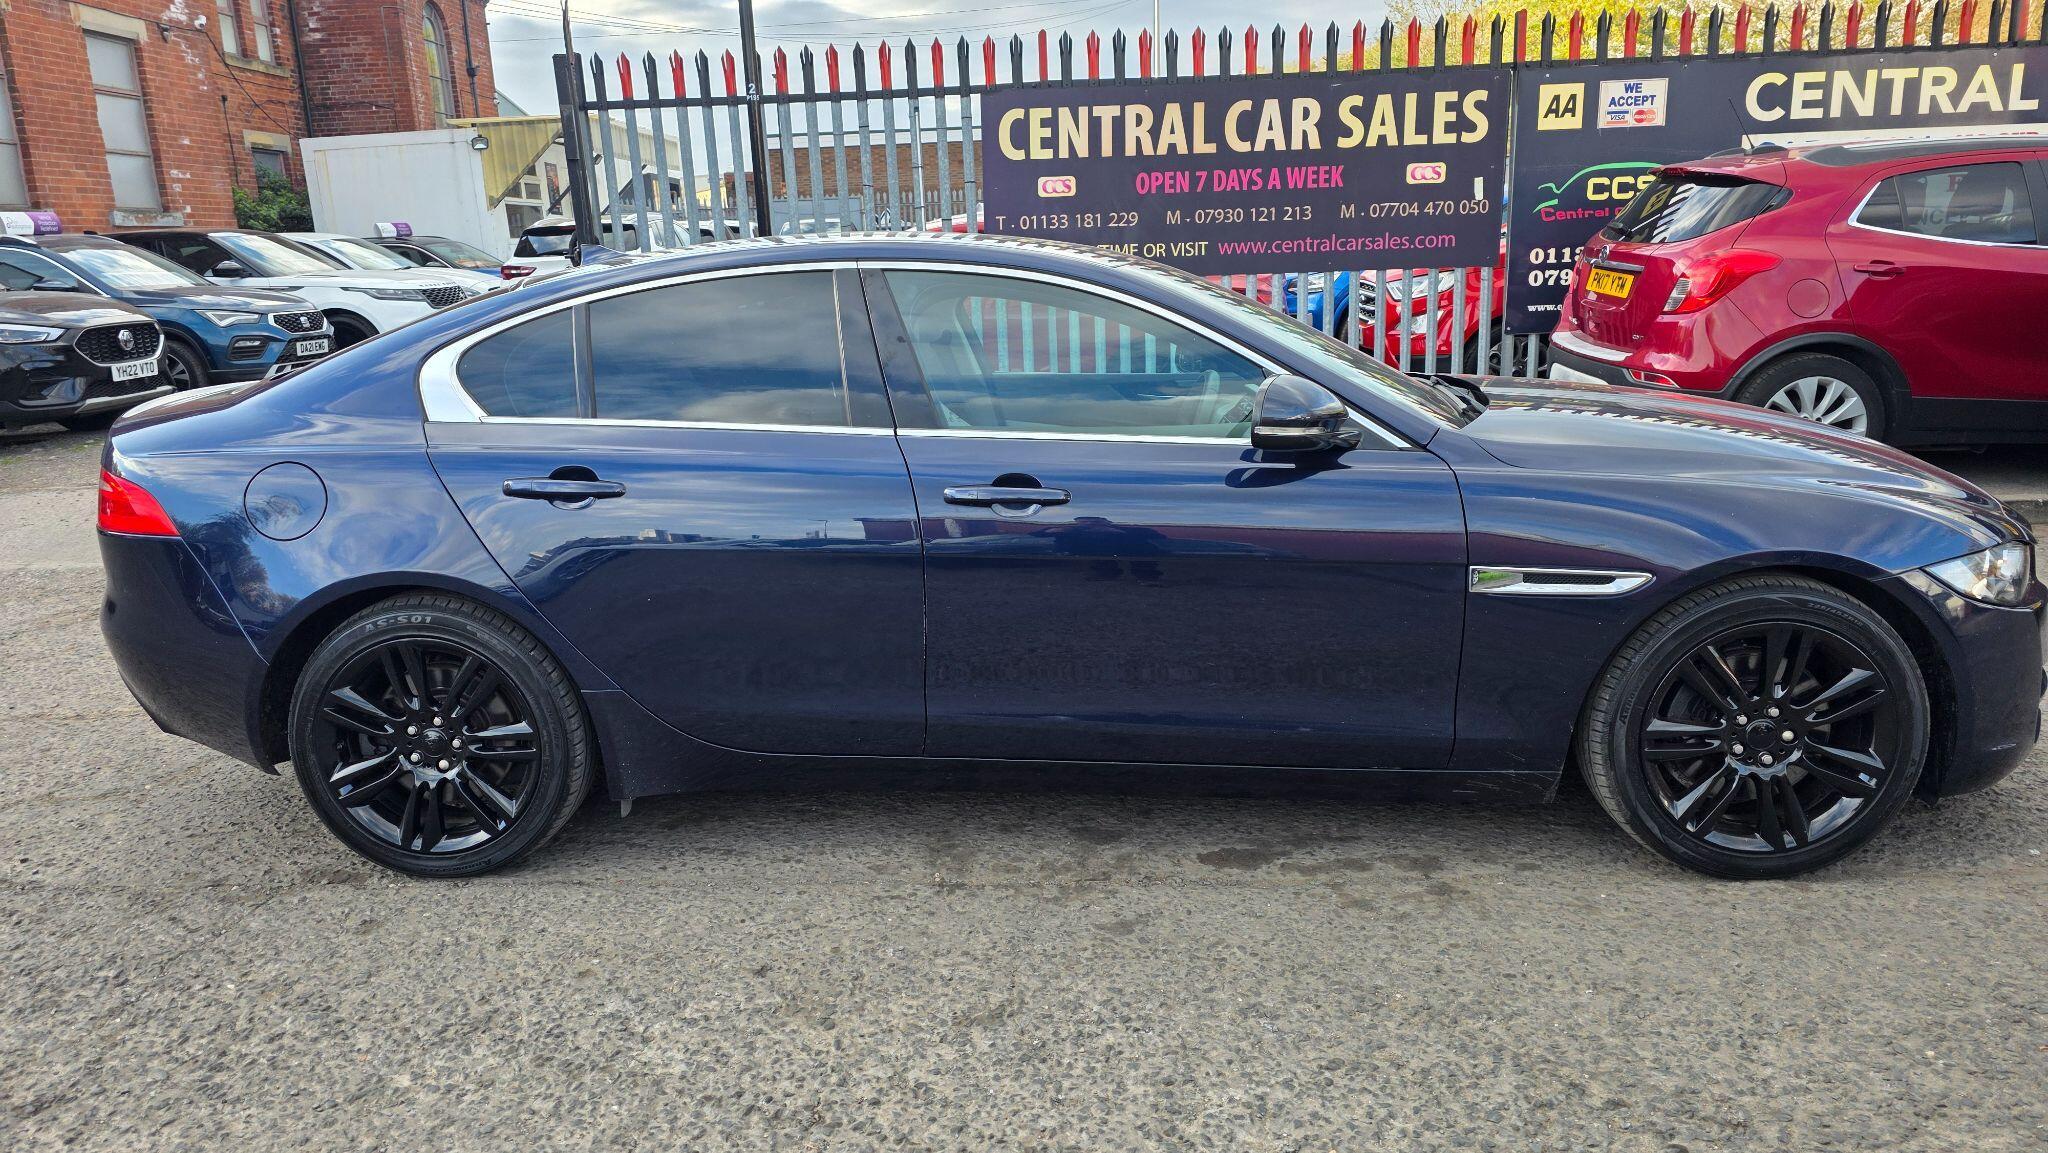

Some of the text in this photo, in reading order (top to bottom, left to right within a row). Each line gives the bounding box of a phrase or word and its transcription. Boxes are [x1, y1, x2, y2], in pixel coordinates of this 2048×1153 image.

[748, 83, 756, 94] 2
[1624, 83, 1642, 93] WE
[1746, 63, 2039, 122] CENTRAL
[1543, 94, 1577, 118] AA
[1608, 95, 1656, 107] ACCEPT
[998, 89, 1489, 161] CENTRAL CAR SALES
[1136, 165, 1345, 195] OPEN 7 DAYS A WEEK
[1410, 165, 1444, 182] CCS
[1041, 179, 1072, 194] CCS
[1195, 208, 1244, 223] 07930
[1250, 207, 1276, 221] 121
[1283, 205, 1312, 221] 213
[1369, 202, 1420, 218] 07704
[1424, 201, 1455, 216] 470
[1459, 199, 1490, 215] 050
[1540, 207, 1610, 222] Central
[1019, 215, 1069, 230] 01133
[1075, 213, 1101, 228] 181
[1109, 212, 1139, 227] 229
[1143, 243, 1166, 258] OR
[1170, 241, 1209, 257] VISIT
[1218, 232, 1456, 256] www.centralcarsales.com
[116, 364, 139, 378] YH22
